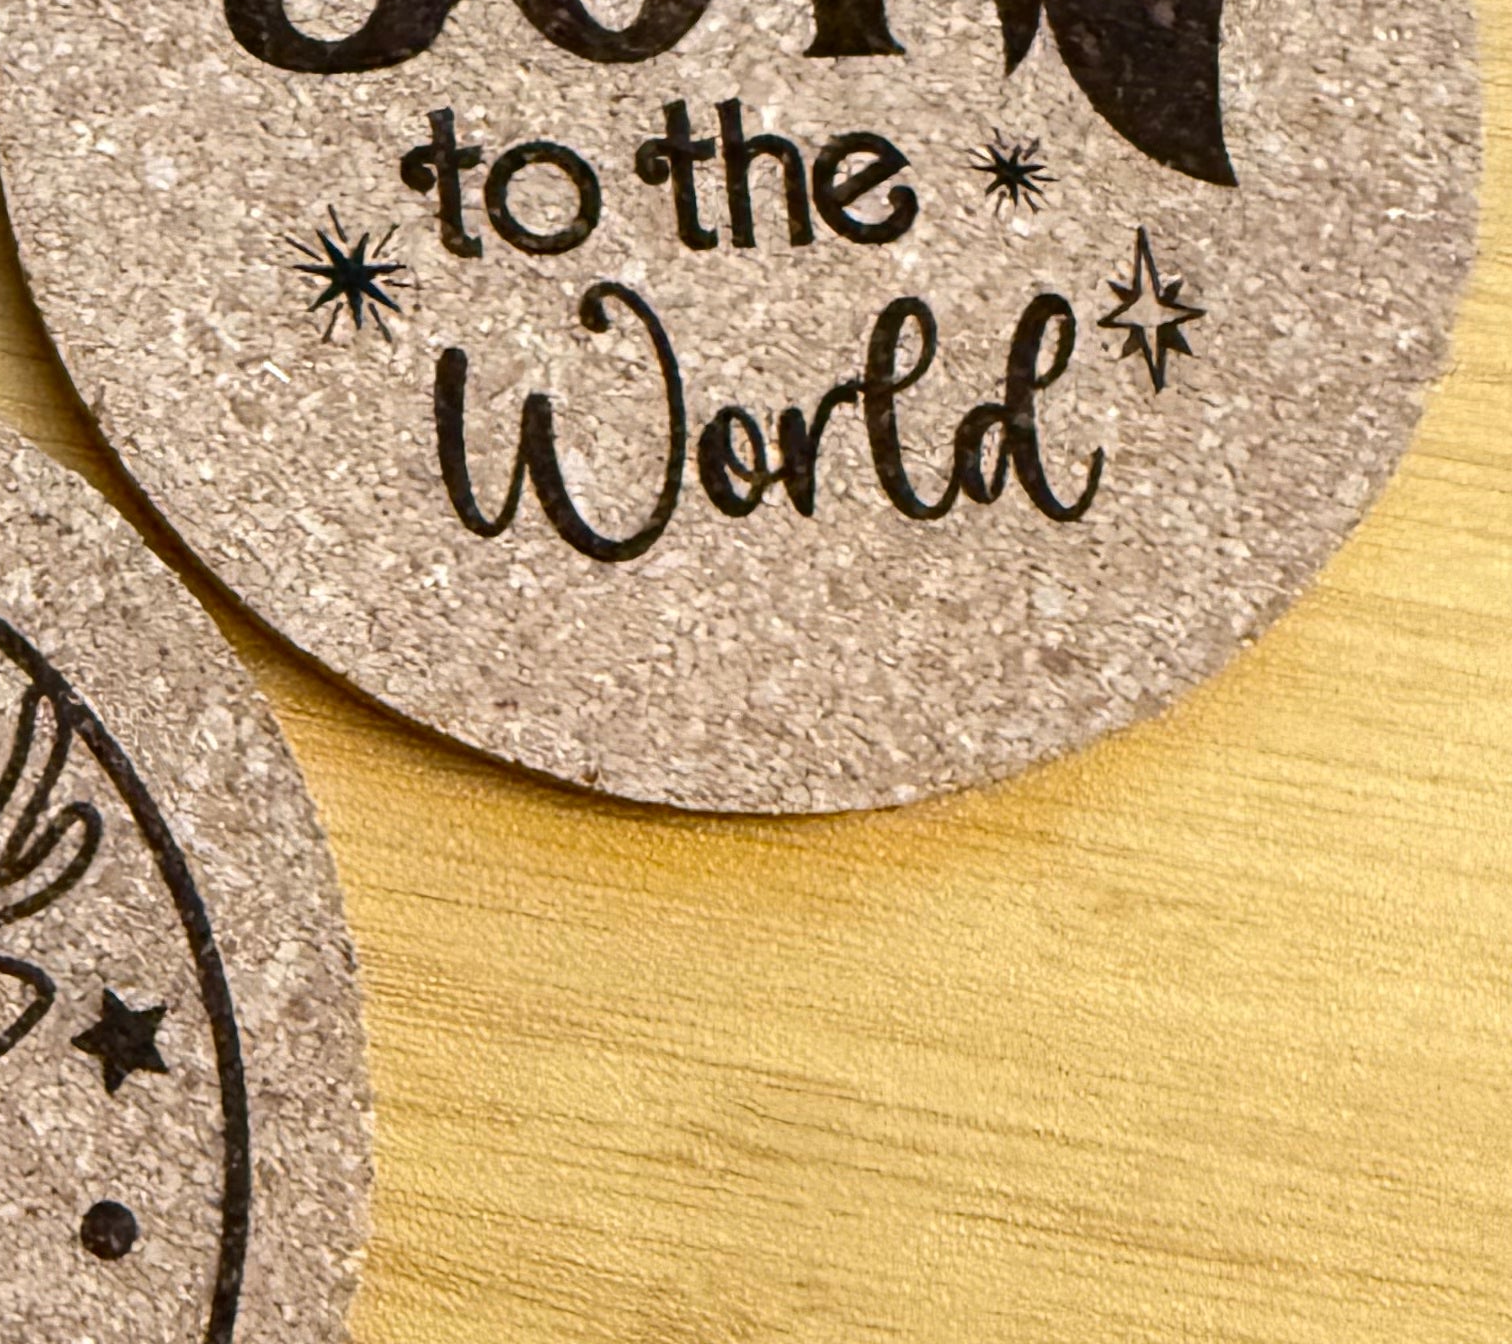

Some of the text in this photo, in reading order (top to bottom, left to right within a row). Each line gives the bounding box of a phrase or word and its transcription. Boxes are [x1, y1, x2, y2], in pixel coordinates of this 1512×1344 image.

[399, 97, 919, 256] to the
[433, 280, 1104, 563] World
